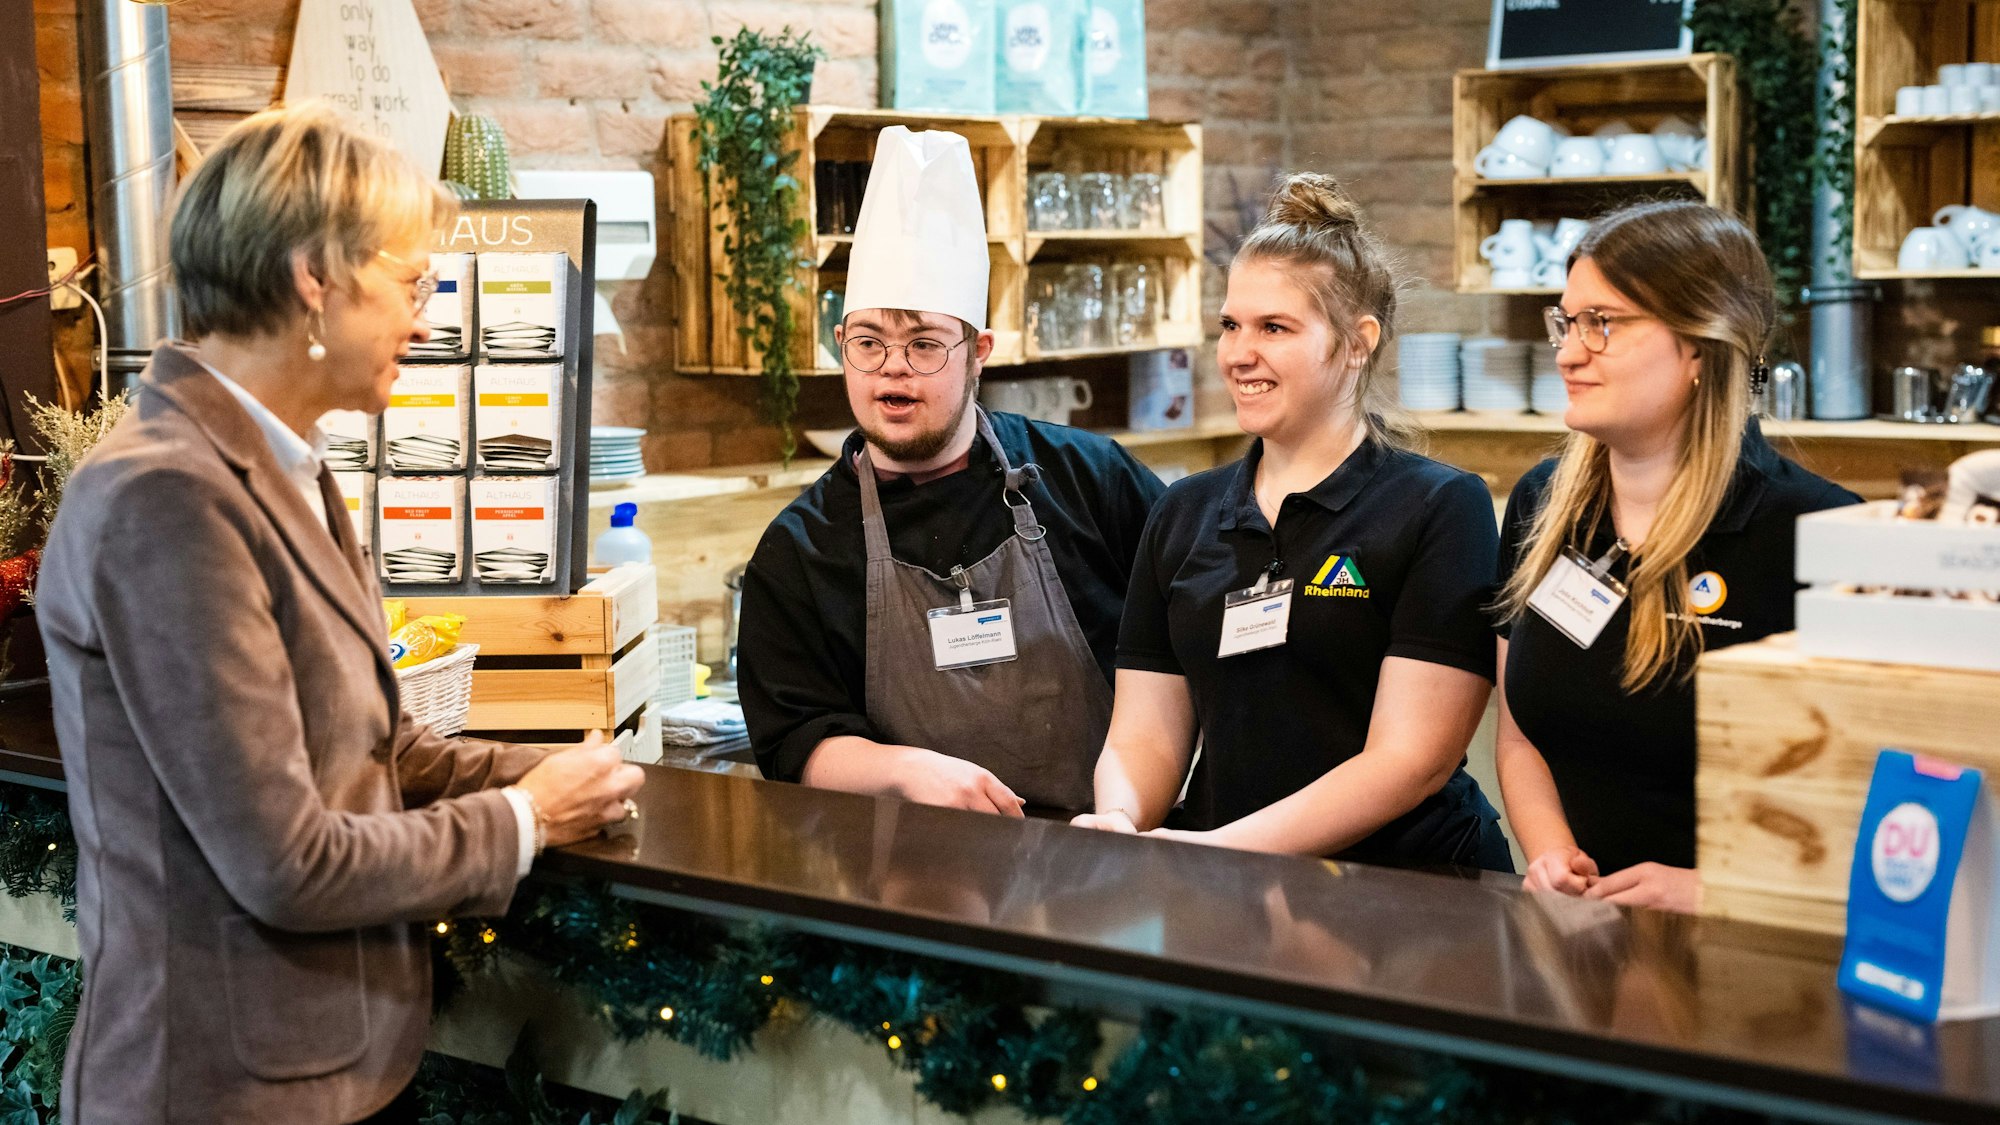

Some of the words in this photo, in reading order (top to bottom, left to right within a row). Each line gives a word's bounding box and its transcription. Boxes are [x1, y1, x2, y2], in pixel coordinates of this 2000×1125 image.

[340, 0, 374, 32] only
[344, 34, 375, 62] way
[348, 55, 365, 82] to
[372, 55, 391, 82] do
[370, 86, 411, 112] work
[373, 115, 391, 138] to
[490, 377, 537, 386] ALTHAUS
[394, 490, 440, 499] ALTHAUS
[486, 491, 532, 499] ALTHAUS
[1304, 585, 1370, 598] Rheinland
[967, 632, 1001, 640] Löffelmann
[1883, 822, 1930, 858] DU
